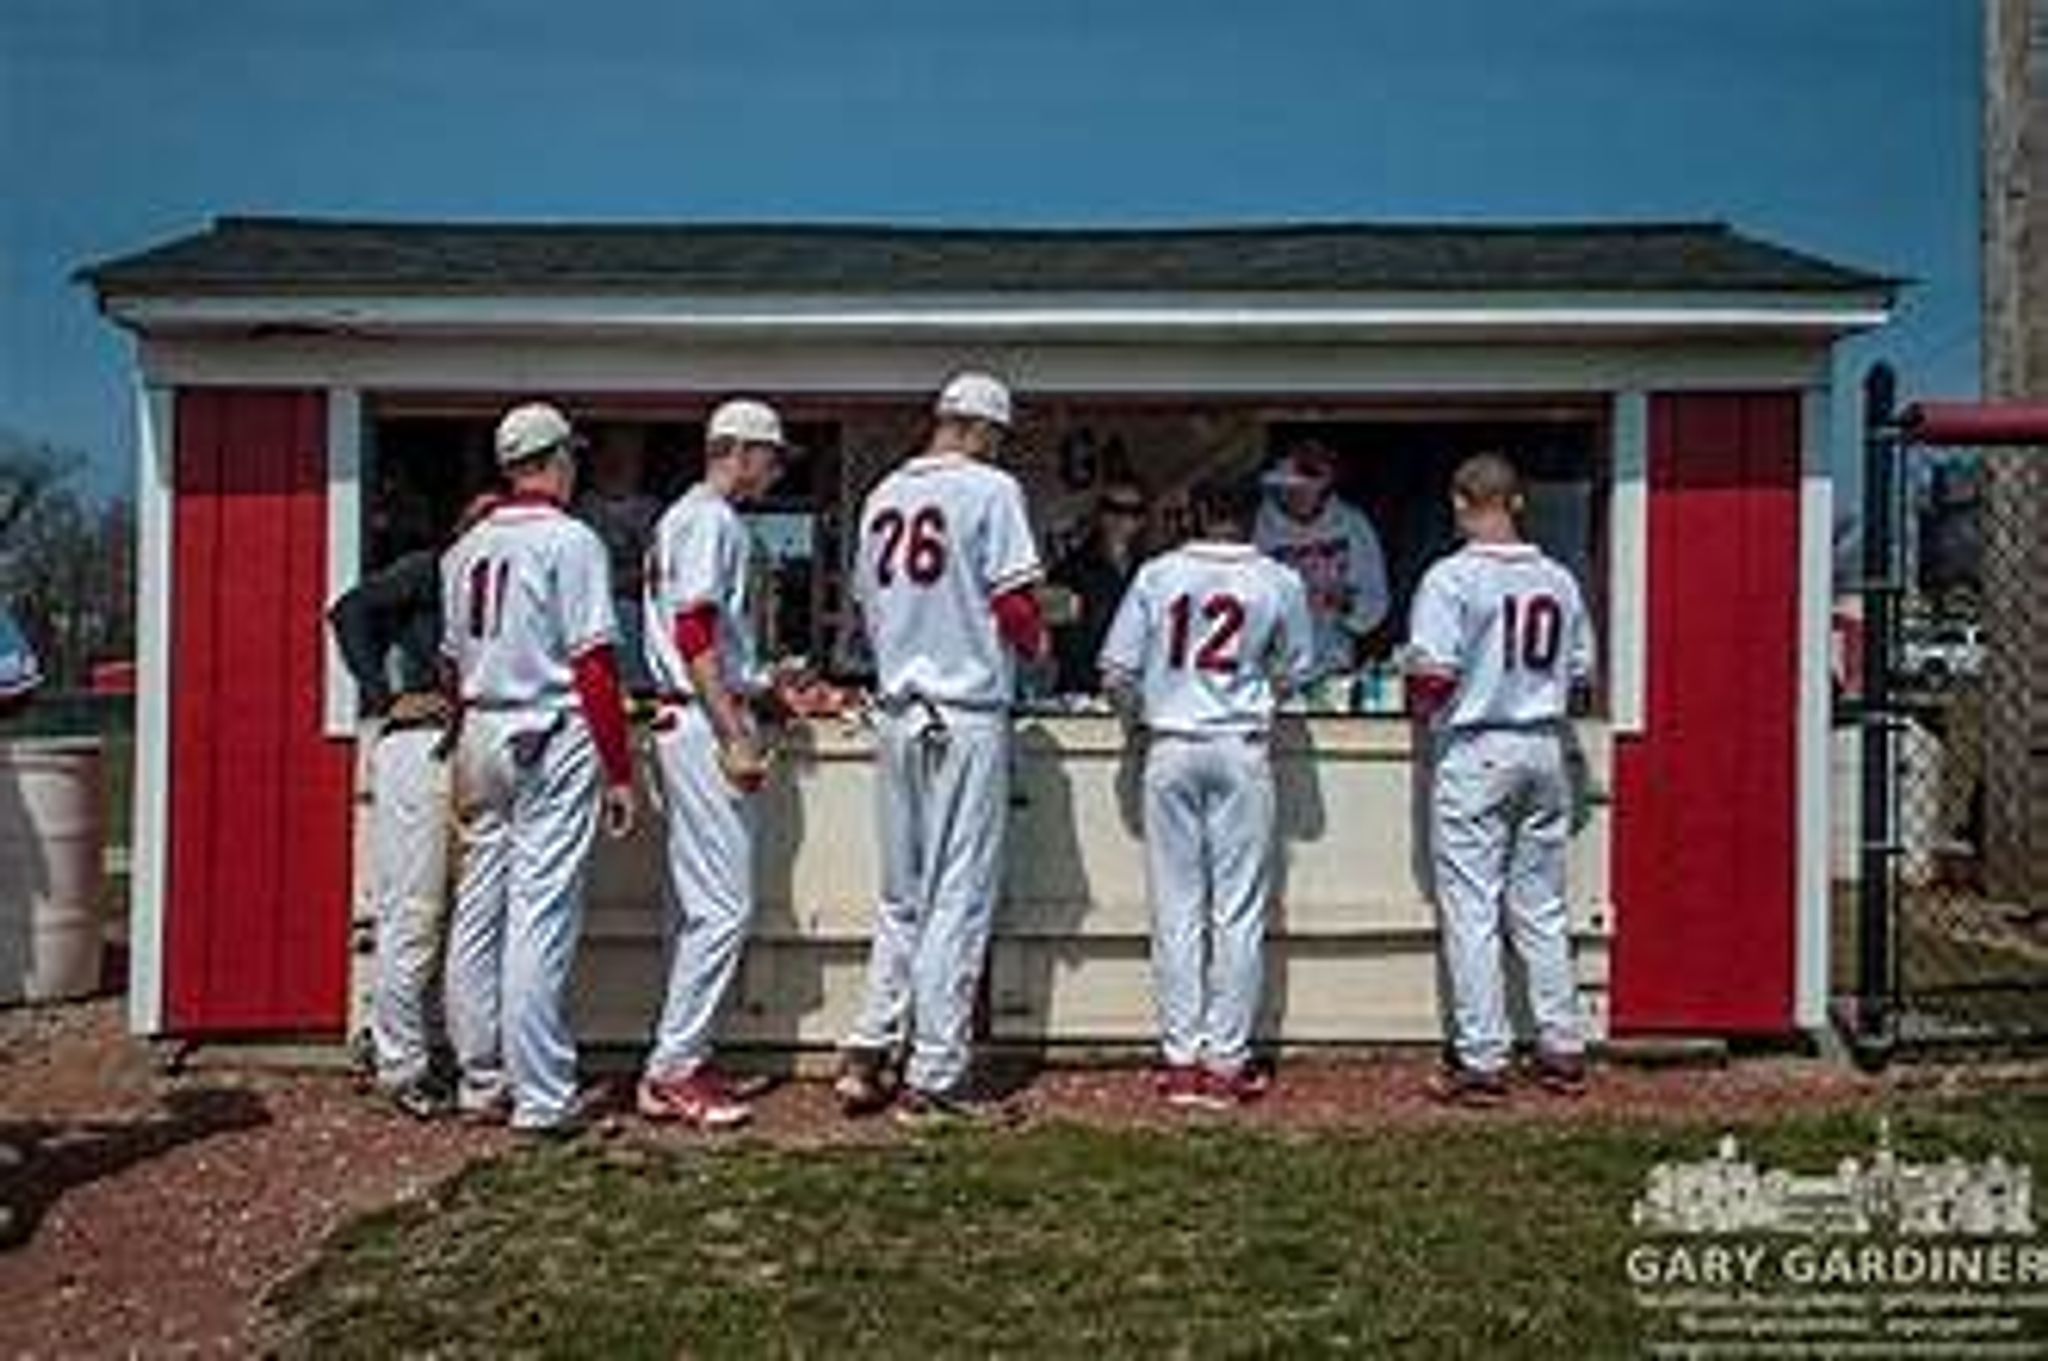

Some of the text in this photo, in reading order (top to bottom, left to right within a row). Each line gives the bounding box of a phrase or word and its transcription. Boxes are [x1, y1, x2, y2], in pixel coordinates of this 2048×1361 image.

[468, 556, 509, 638] 11
[1168, 593, 1245, 672] 12
[1502, 593, 1562, 671] 10
